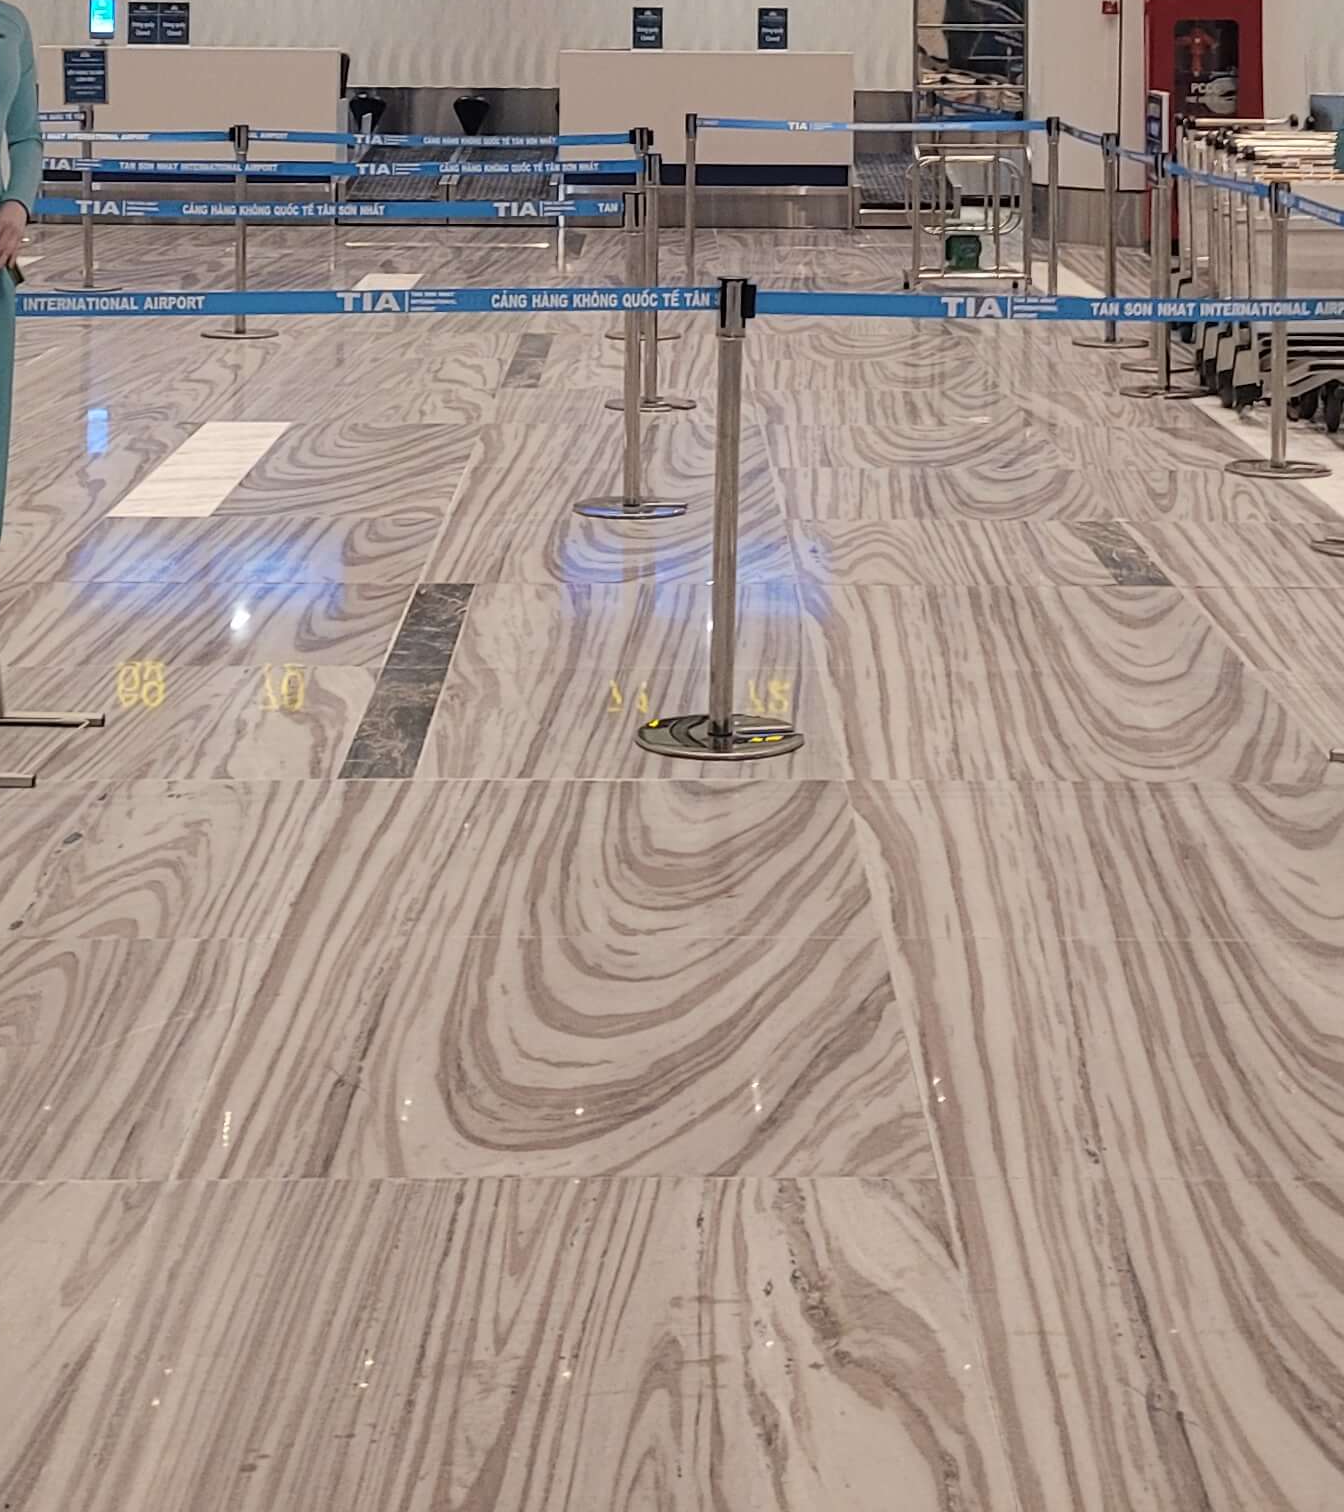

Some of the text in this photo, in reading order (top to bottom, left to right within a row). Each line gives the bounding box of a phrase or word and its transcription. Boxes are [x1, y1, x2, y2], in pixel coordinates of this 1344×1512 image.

[787, 121, 808, 130] TIA
[354, 134, 384, 144] TIA
[41, 158, 70, 170] TIA
[244, 163, 278, 172] AIRPORT
[356, 163, 390, 175] TIA
[75, 200, 120, 215] TIA
[493, 201, 618, 216] TIA TAN
[23, 295, 205, 311] INTERNATIONAL AIRPORT
[336, 291, 401, 312] TIA
[491, 289, 528, 309] CẢNG
[532, 289, 567, 309] HÀNG
[573, 290, 618, 308] KHÔNG
[622, 288, 659, 309] QUỐC
[663, 288, 681, 308] TẾ
[684, 289, 710, 308] TÂN
[940, 296, 1004, 318] TIA
[1090, 302, 1120, 317] TAN
[1123, 302, 1153, 317] SON
[1157, 302, 1197, 317] NHAT
[1199, 301, 1311, 317] INTERNATIONAL
